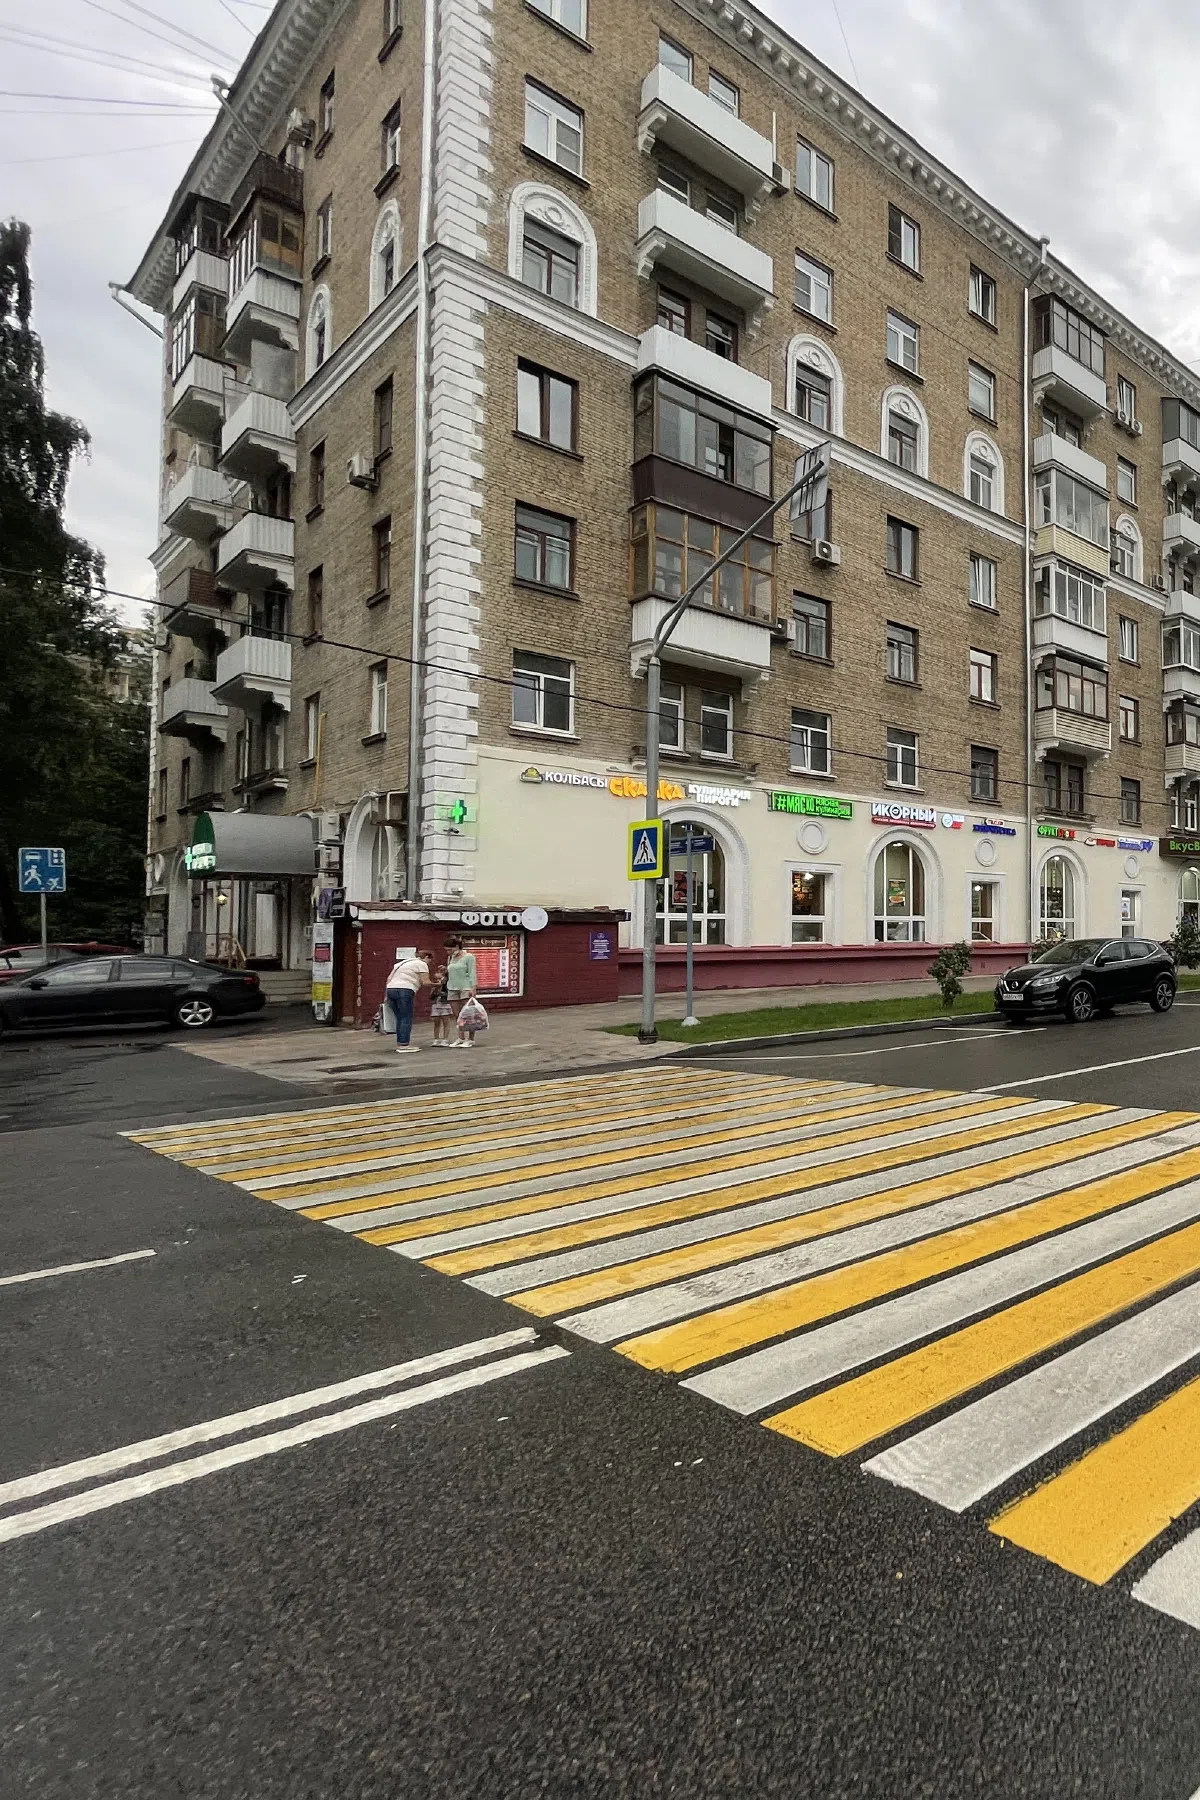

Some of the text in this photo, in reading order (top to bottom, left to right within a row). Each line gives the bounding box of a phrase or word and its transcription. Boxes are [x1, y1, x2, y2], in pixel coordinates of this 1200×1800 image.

[544, 771, 608, 788] КОЛБАСЫ
[609, 776, 685, 801] СКАКА
[688, 783, 751, 800] КУЛИНАРИЯ
[696, 793, 739, 807] ПИРОГИ
[872, 802, 937, 823] ИКОРНЫЙ
[461, 911, 521, 926] ФОТО
